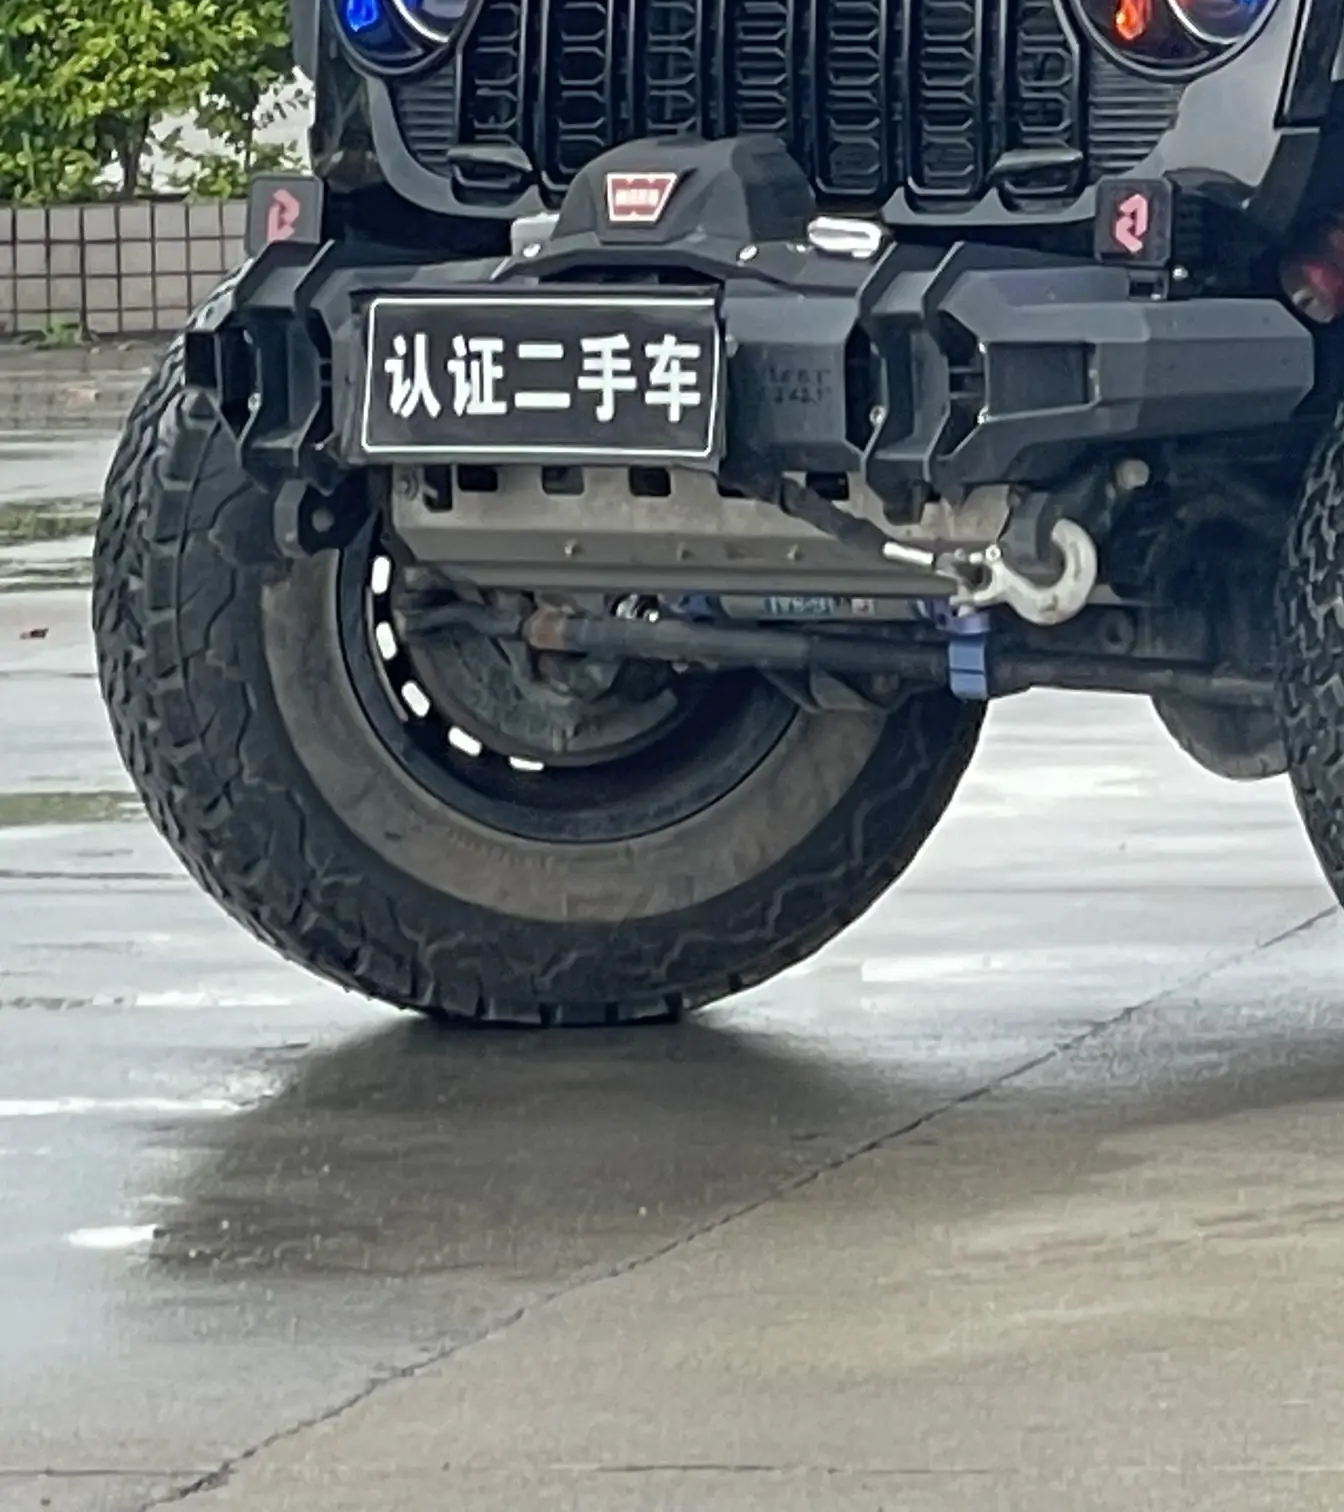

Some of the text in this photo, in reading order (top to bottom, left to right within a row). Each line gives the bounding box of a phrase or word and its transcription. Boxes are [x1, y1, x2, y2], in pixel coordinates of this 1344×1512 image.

[384, 332, 702, 424] 认证二手车
